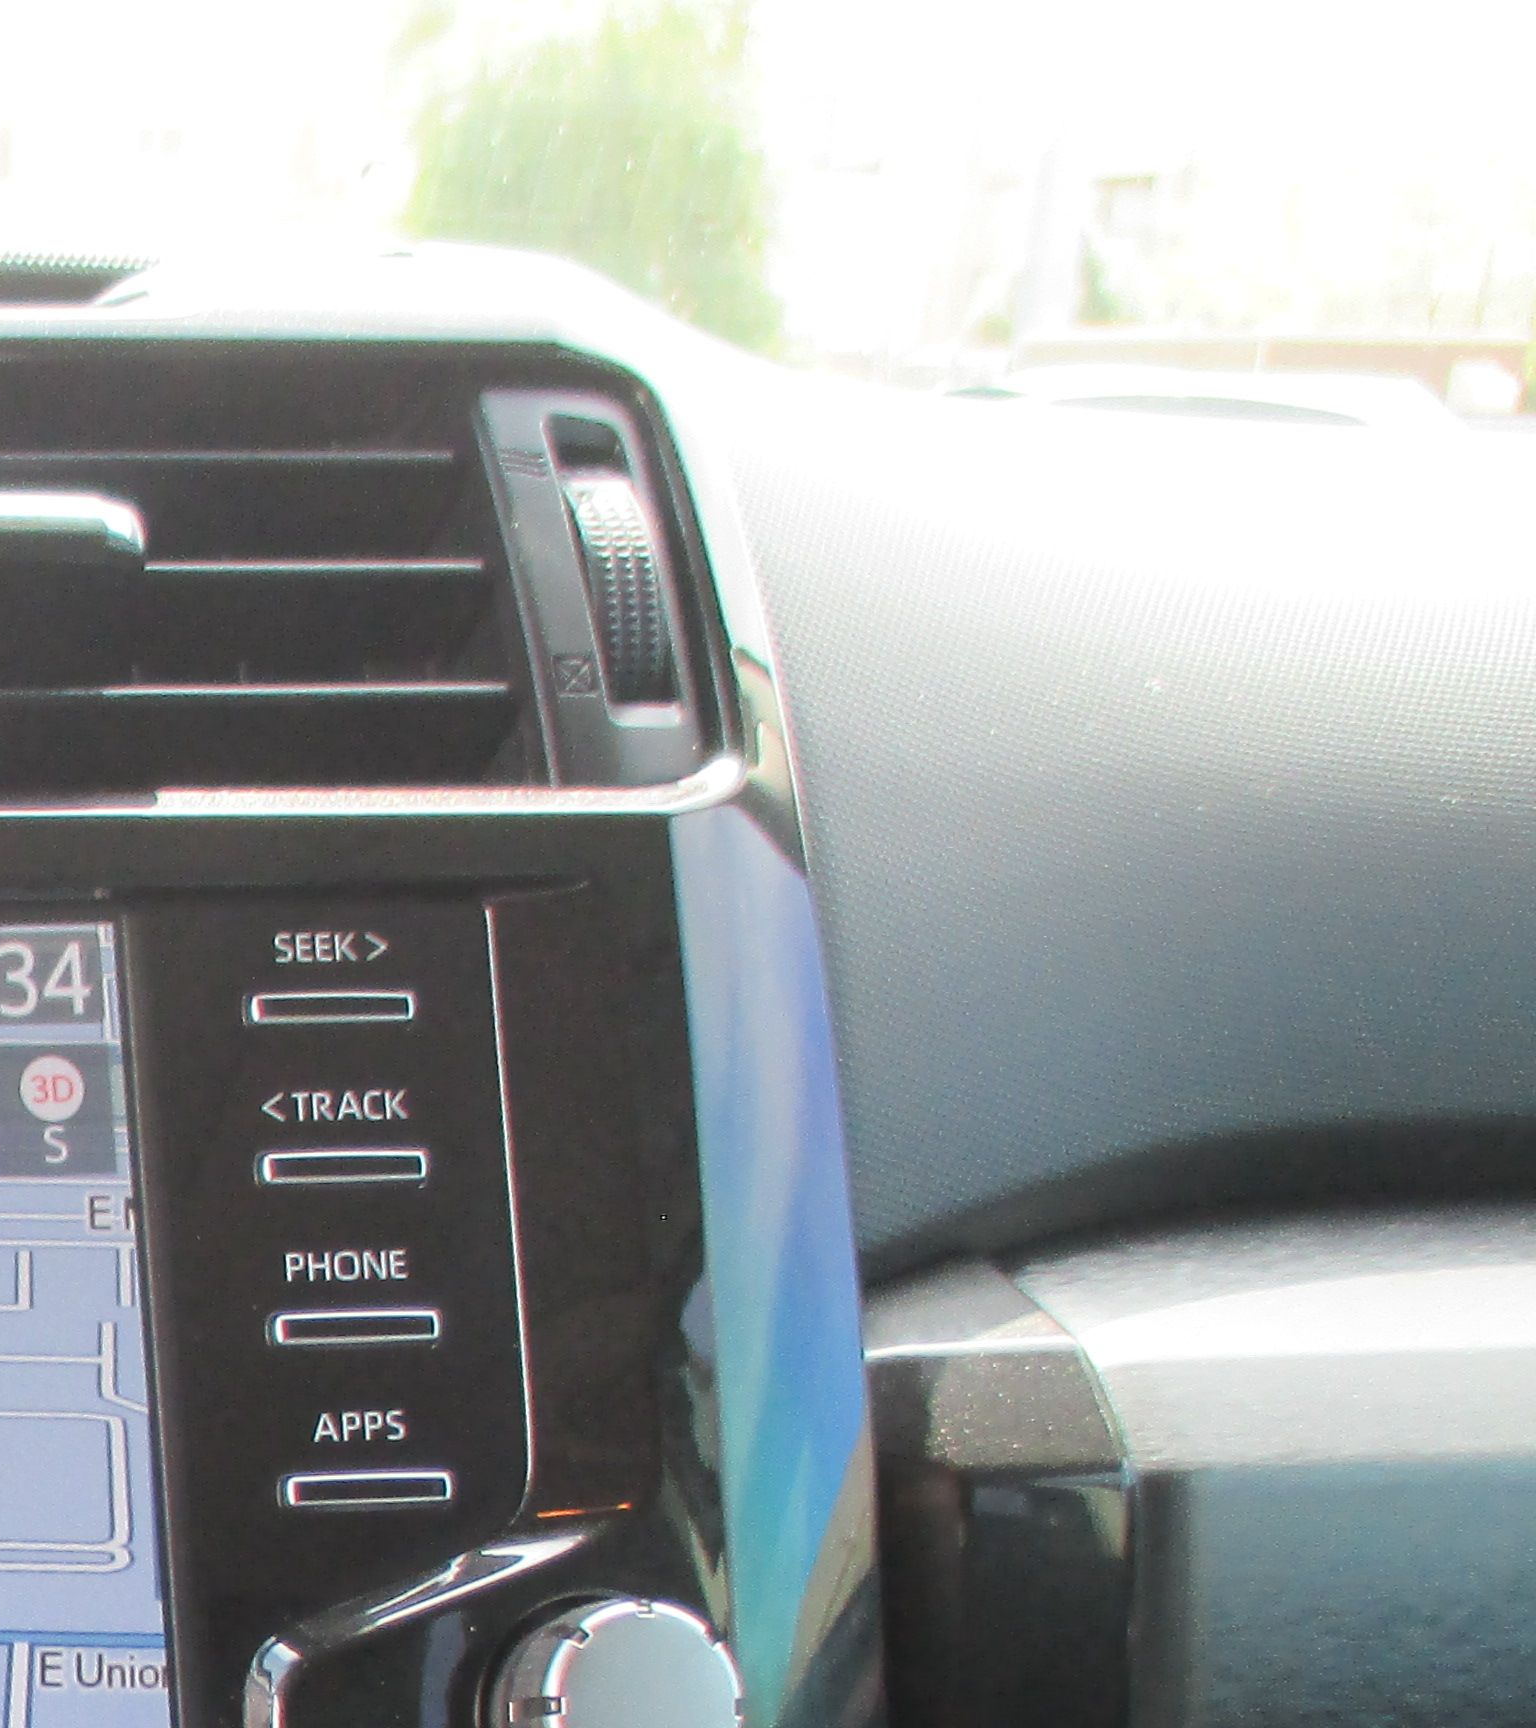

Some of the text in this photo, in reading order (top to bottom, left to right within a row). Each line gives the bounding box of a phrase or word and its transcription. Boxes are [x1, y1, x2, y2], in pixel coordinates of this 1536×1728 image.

[29, 1074, 75, 1104] 3D
[43, 1125, 69, 1163] S
[89, 1195, 111, 1230] E
[284, 1249, 409, 1282] PHONE
[313, 1410, 407, 1443] APPS
[39, 1651, 64, 1688] E
